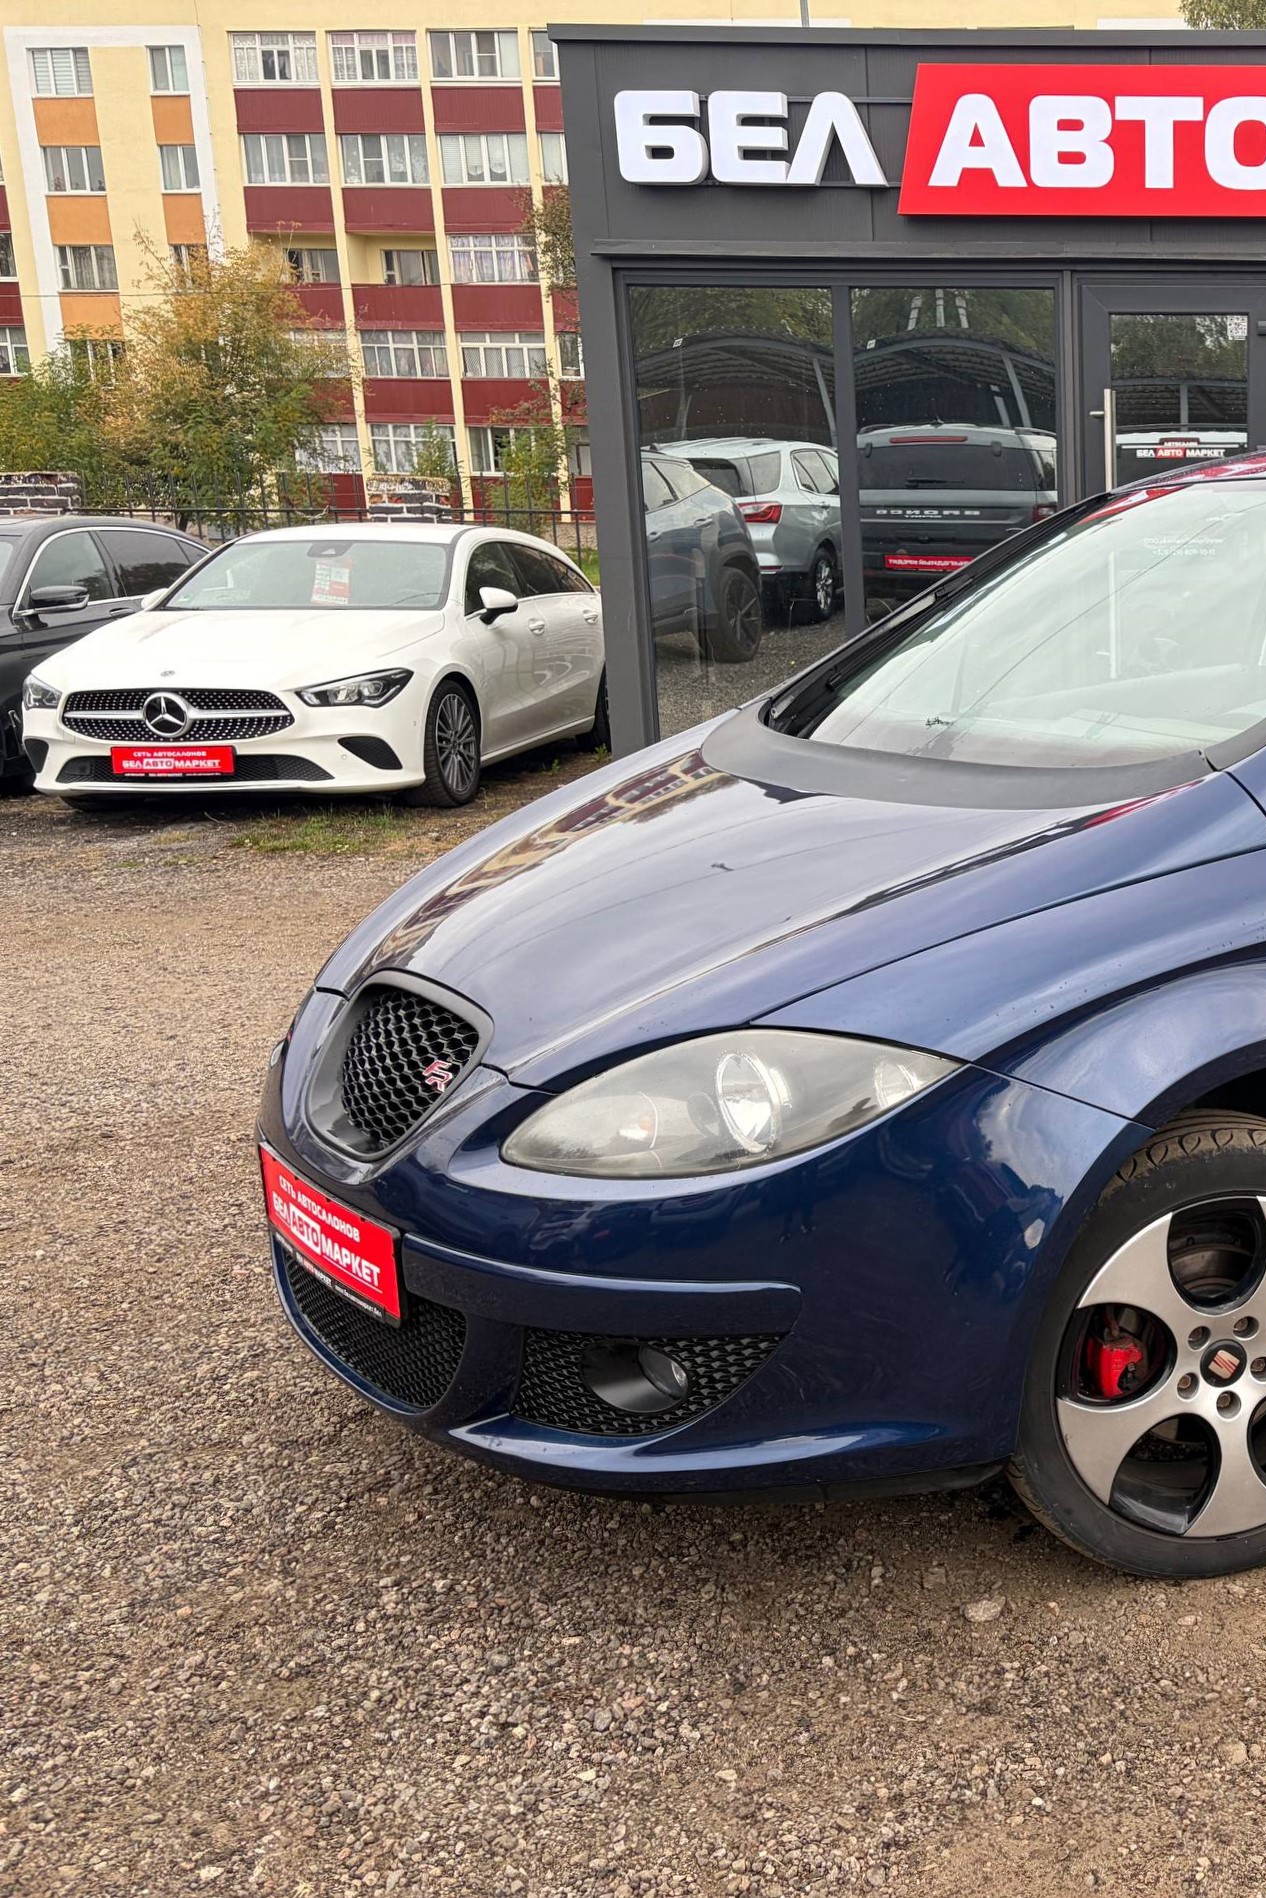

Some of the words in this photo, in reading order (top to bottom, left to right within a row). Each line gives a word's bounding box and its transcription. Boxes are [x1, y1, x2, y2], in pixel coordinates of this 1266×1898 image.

[614, 90, 889, 187] БЕЛ
[1136, 449, 1155, 458] БЕЛ
[1157, 449, 1183, 457] АВТО
[1186, 449, 1226, 458] МАРКЕТ
[122, 759, 143, 769] БЕЛ
[144, 760, 173, 769] АВТО
[174, 759, 221, 769] МАРКЕТ
[153, 750, 207, 758] АВТОСАЛОНОВ
[278, 1174, 297, 1200] СЕТЬ
[297, 1191, 361, 1243] АВТОСАЛОНОВ
[272, 1191, 291, 1225] БЕЛ
[291, 1207, 320, 1249] АВТО
[321, 1233, 381, 1287] МАРКЕТ
